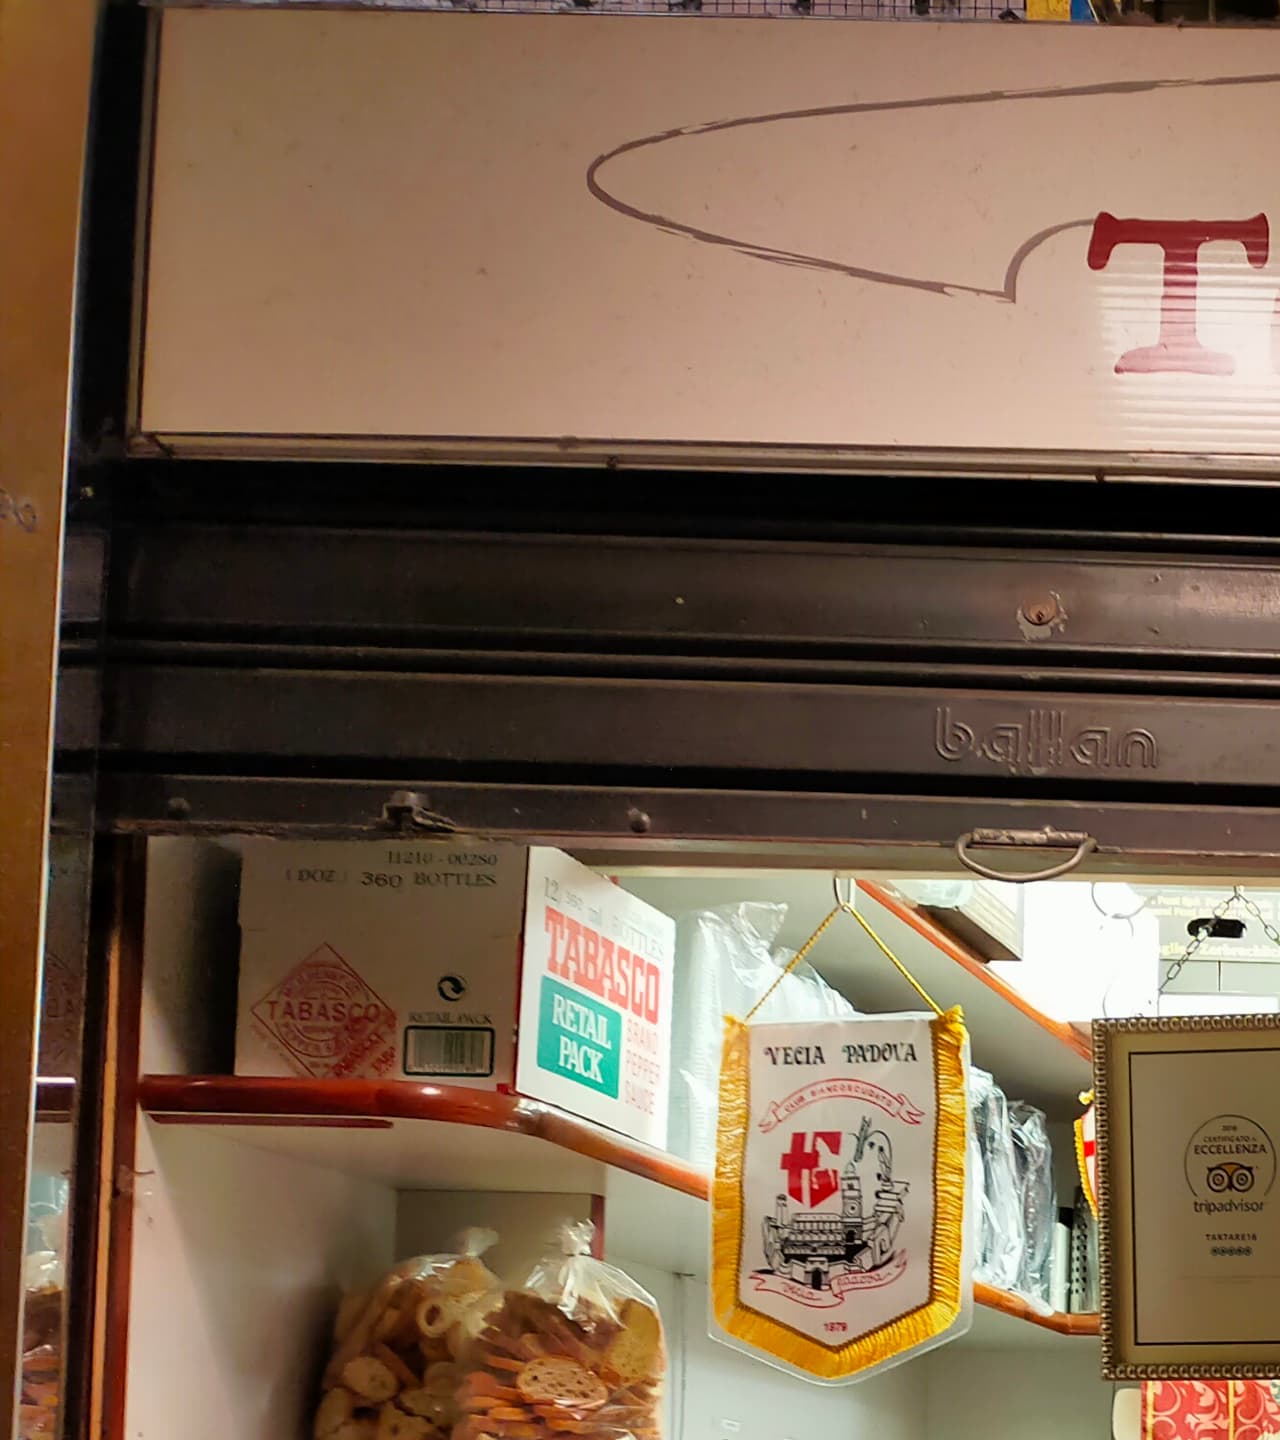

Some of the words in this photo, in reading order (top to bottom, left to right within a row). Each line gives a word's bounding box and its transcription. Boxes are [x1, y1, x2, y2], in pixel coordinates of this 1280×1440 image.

[935, 706, 1159, 772] ballan
[361, 871, 403, 888] 360
[414, 872, 497, 887] BOTTLES
[545, 905, 660, 1025] TABASCO
[267, 1001, 381, 1022] TABASCO
[552, 993, 612, 1050] RETAIL
[558, 1035, 603, 1084] PACK
[764, 1045, 826, 1066] VECIA
[842, 1043, 918, 1065] PADOVA
[1194, 1143, 1268, 1156] ECCELLENZA
[1193, 1199, 1265, 1216] tripadvisor
